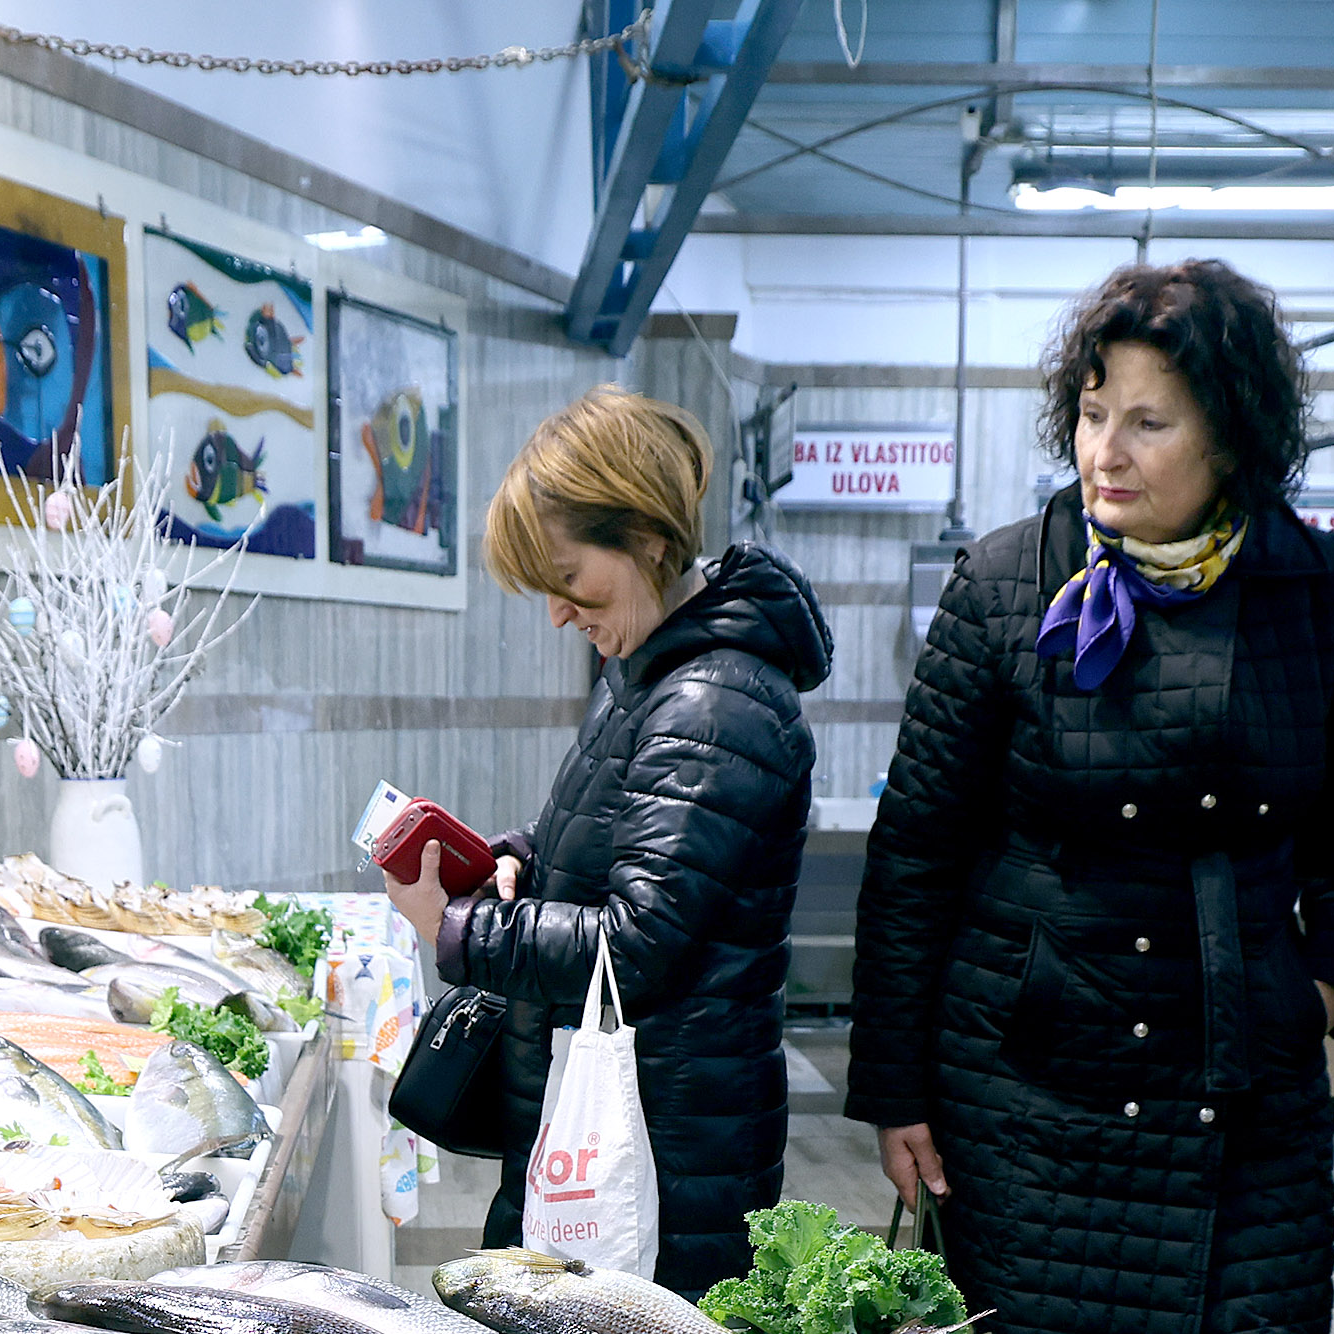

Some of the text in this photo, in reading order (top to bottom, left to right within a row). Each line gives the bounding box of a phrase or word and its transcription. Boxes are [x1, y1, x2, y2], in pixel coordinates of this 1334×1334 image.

[826, 441, 843, 463] IZ
[851, 441, 955, 464] VLASTITOG
[832, 471, 900, 493] ULOVA
